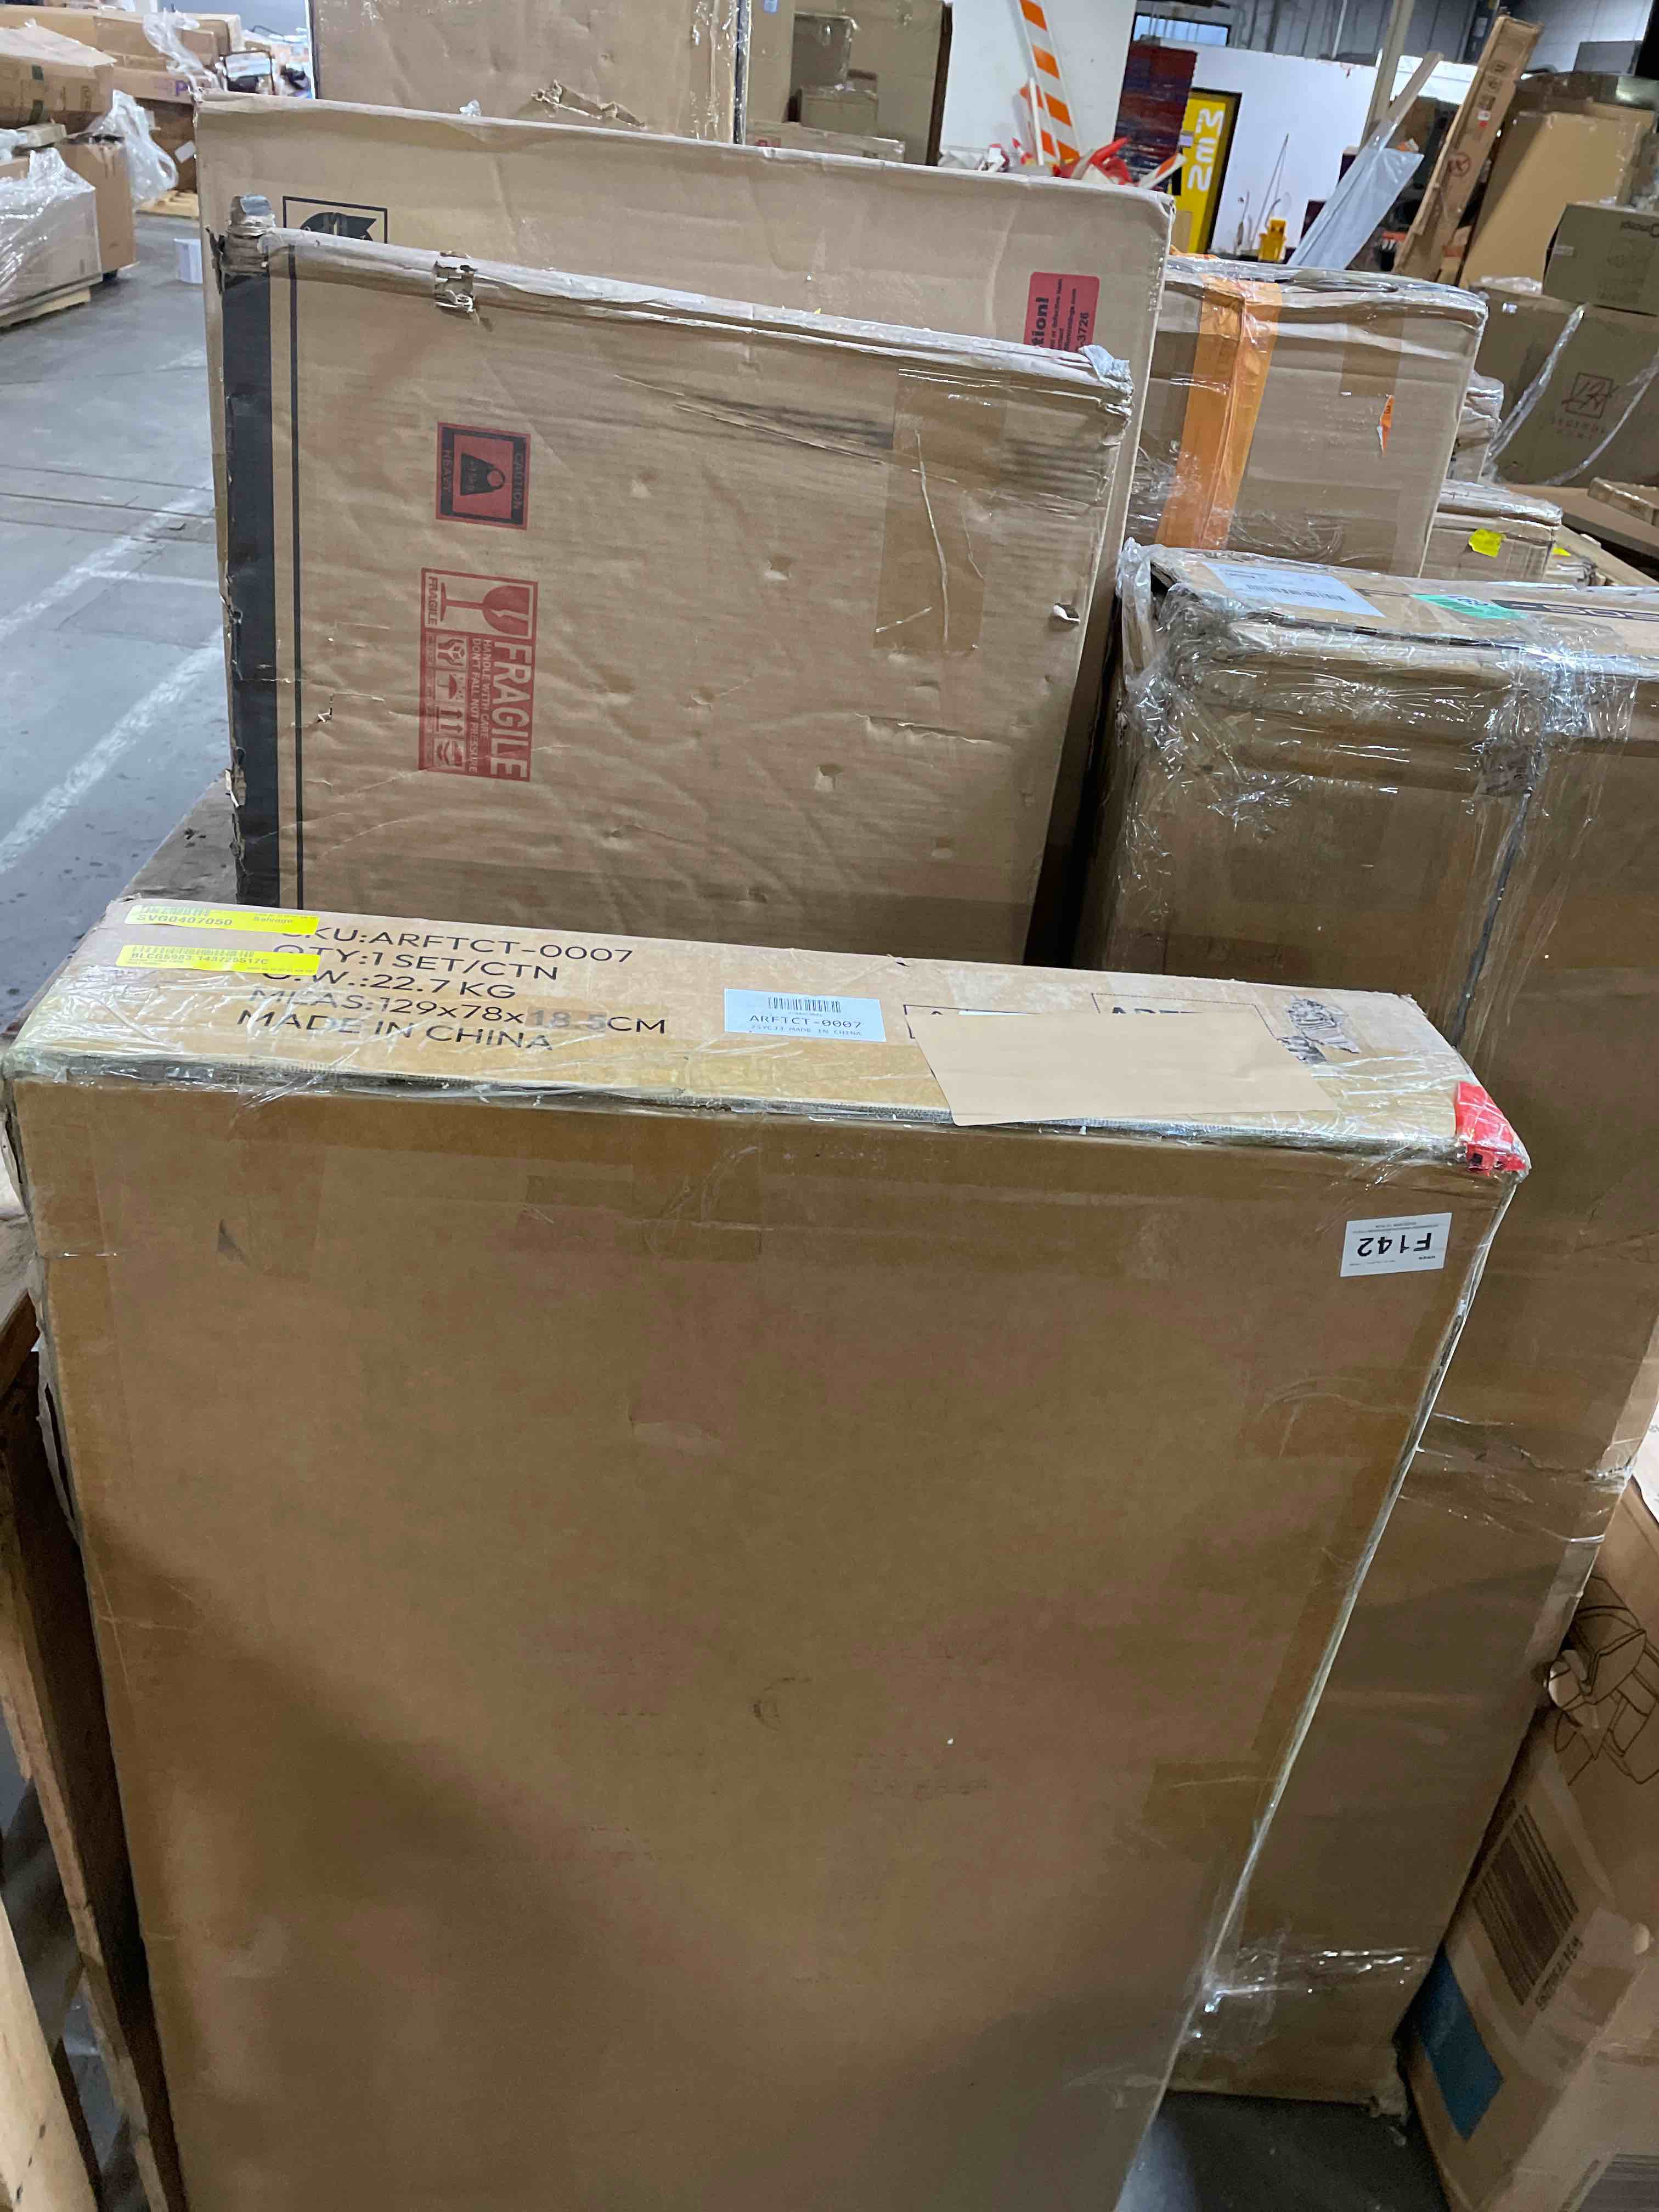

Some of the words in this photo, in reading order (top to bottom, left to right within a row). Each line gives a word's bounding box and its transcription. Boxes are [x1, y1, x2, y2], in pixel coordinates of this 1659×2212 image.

[443, 449, 453, 493] HEAVY
[513, 452, 523, 510] CAUTION
[427, 575, 439, 625] FRAGILE
[472, 638, 482, 669] DON'T
[482, 640, 492, 680] HANDLE
[471, 672, 481, 694] FALL
[481, 682, 491, 710] WITH
[470, 697, 479, 720] NOT
[490, 641, 532, 777] FRAGILE
[481, 714, 489, 739] CARE
[469, 723, 479, 773] PRESSURE
[281, 927, 633, 963] KU:ARFTCT-0007
[460, 981, 516, 999] KG
[374, 1020, 414, 1038] IN
[426, 1025, 552, 1051] CHINA
[749, 1015, 862, 1029] ARFTCT-0007
[1357, 1232, 1432, 1257] F142
